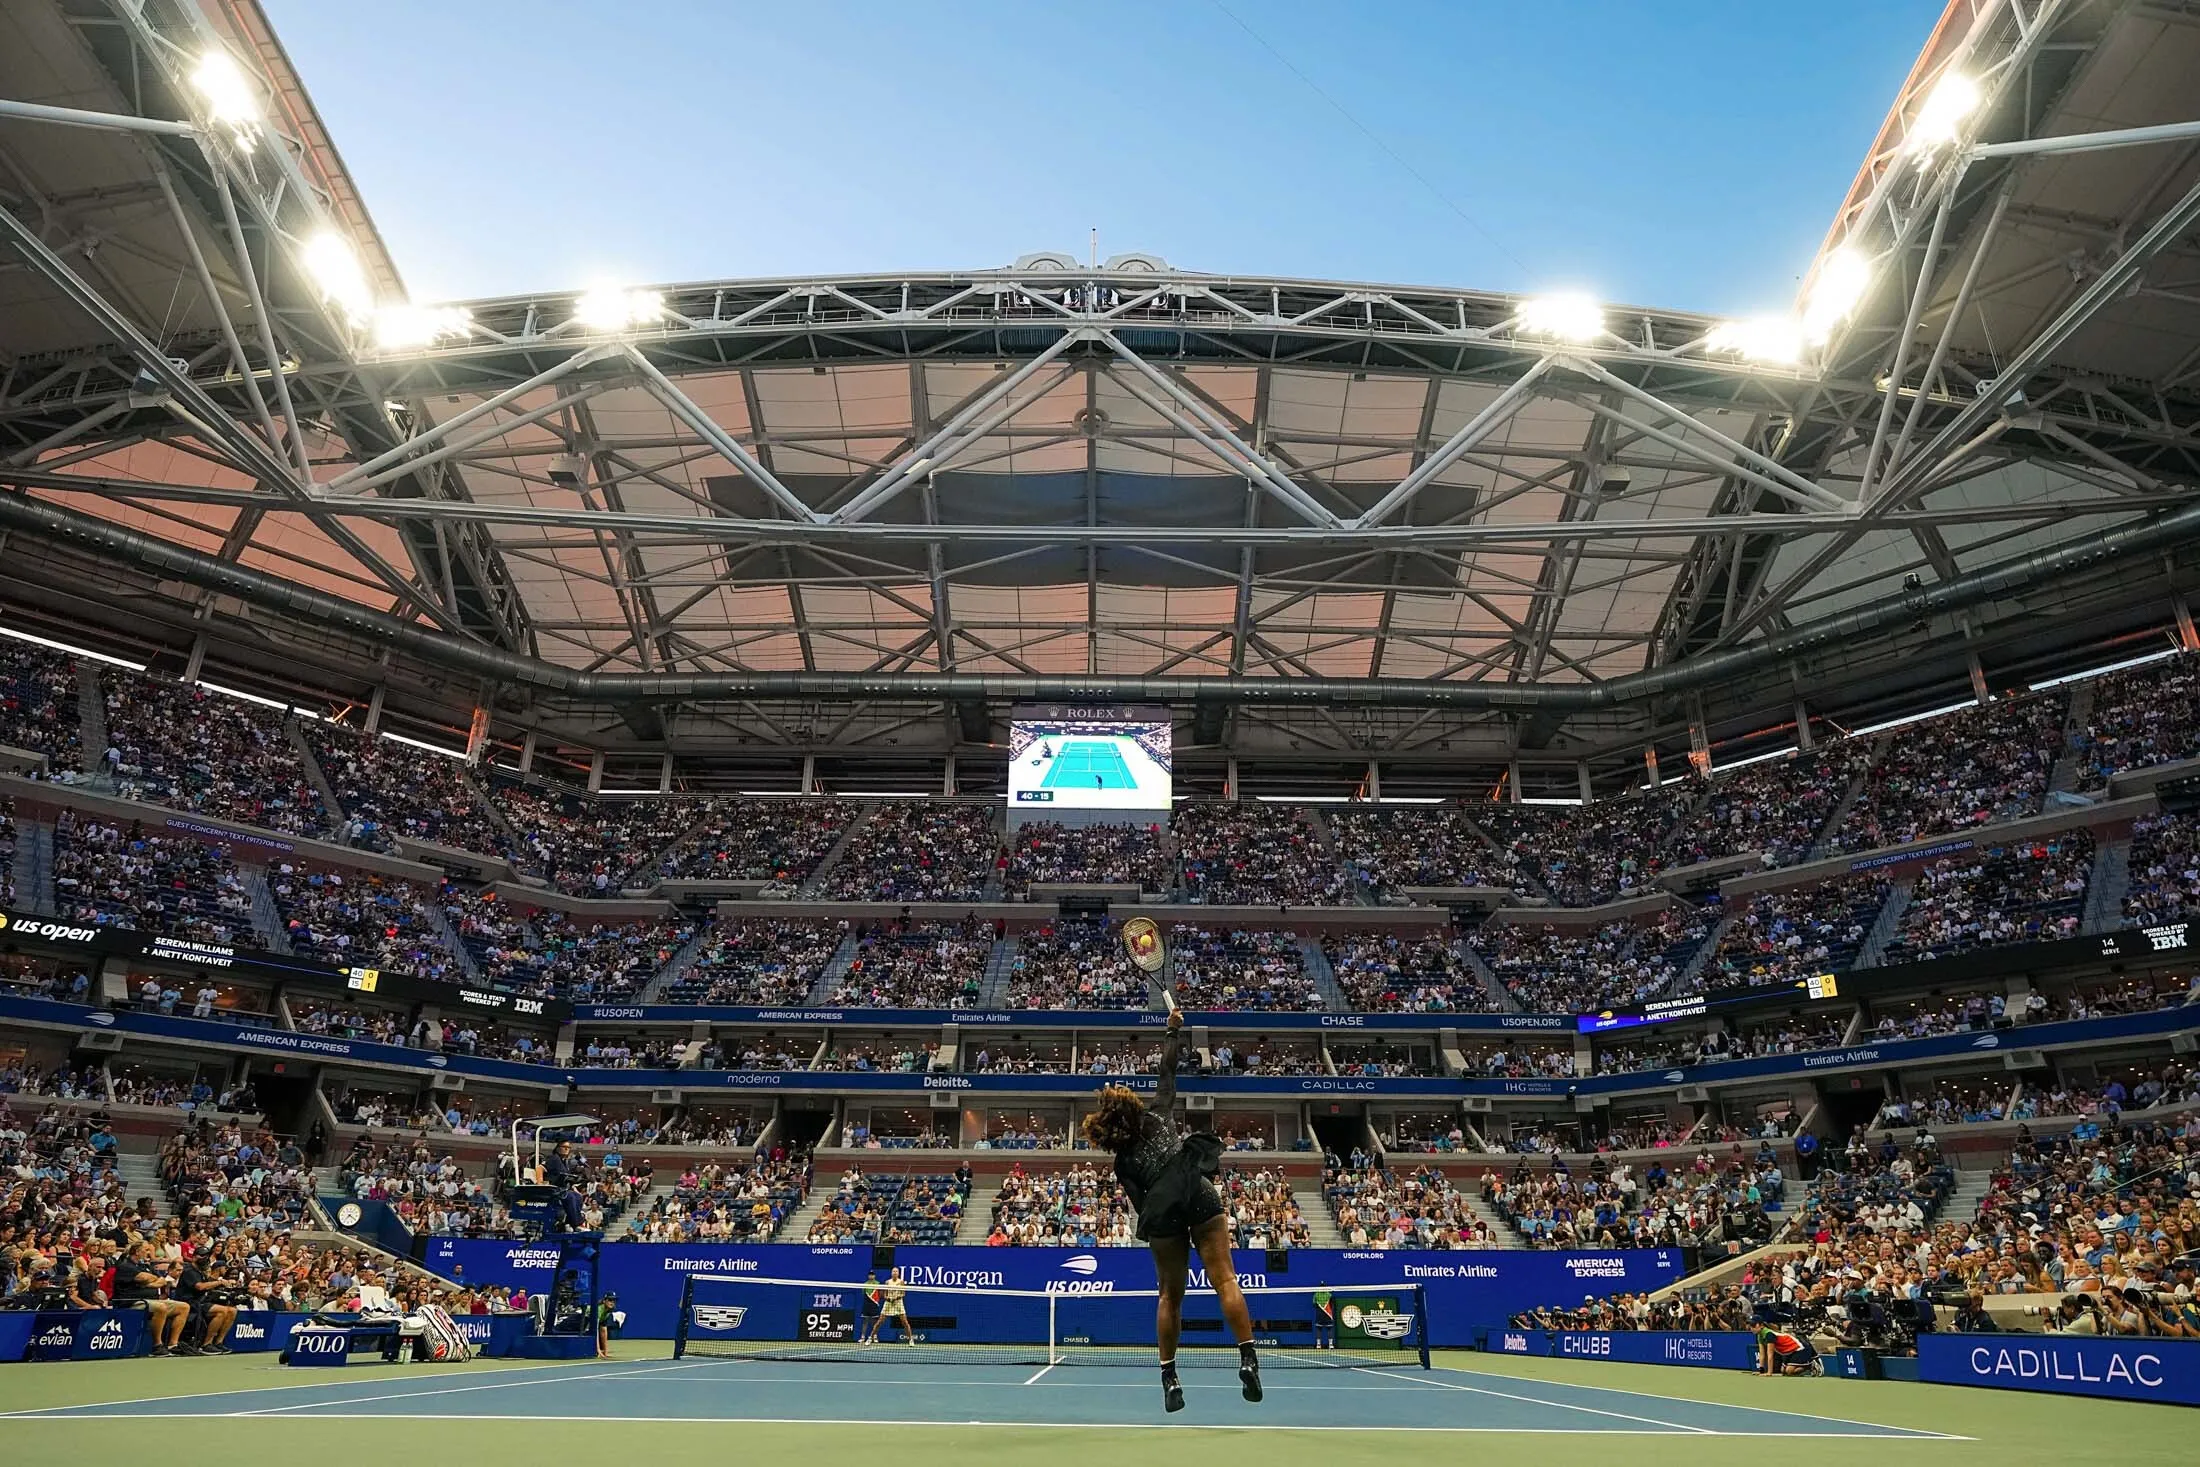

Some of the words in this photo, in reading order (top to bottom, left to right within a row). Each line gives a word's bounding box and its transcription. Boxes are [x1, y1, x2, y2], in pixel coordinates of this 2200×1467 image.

[1067, 708, 1115, 719] ROLEX
[1021, 792, 1033, 800] 40
[166, 819, 190, 829] GUEST
[190, 824, 228, 837] CONCERN?
[229, 832, 246, 841] TEXT
[1851, 861, 1872, 870] GUEST
[1908, 850, 1925, 859] TEXT
[12, 918, 41, 934] us
[40, 923, 96, 942] open
[2142, 926, 2165, 935] SCORES
[2148, 930, 2175, 938] POWERED
[154, 937, 191, 949] SERENA
[192, 943, 234, 956] WILLIAMS
[2102, 938, 2115, 947] 14
[2151, 934, 2187, 950] IBM
[2102, 947, 2120, 955] SERVE
[151, 948, 182, 960] ANETT
[182, 952, 232, 967] KONTAVEIT
[459, 990, 483, 999] SCORES
[488, 994, 506, 1002] STATS
[463, 996, 492, 1006] POWERED
[514, 998, 544, 1015] IBM
[1645, 1001, 1671, 1011] SERENA
[1671, 996, 1705, 1007] WILLIAMS
[593, 1008, 644, 1018] #USOPEN
[757, 1011, 802, 1020] AMERICAN
[803, 1012, 843, 1020] EXPRESS
[952, 1013, 984, 1021] Emirates
[985, 1013, 1011, 1022] Airline
[1646, 1012, 1669, 1021] ANETT
[1669, 1006, 1707, 1017] KONTAVEIT
[1321, 1016, 1364, 1025] CHASE
[1501, 1018, 1562, 1027] USOPEN.ORG
[236, 1032, 298, 1047] AMERICAN
[300, 1040, 351, 1053] EXPRESS
[1803, 1055, 1844, 1066] Emirates
[1846, 1050, 1880, 1061] Airline
[727, 1074, 781, 1084] moderna
[923, 1076, 972, 1088] Deloitte.
[1115, 1080, 1158, 1088] CHUB
[1302, 1081, 1375, 1090] CADILLAC
[1505, 1082, 1526, 1092] IHG
[443, 1241, 453, 1249] 14
[811, 1247, 854, 1255] USOPEN.ORG
[1657, 1251, 1668, 1259] 14
[512, 1260, 560, 1269] EXPRES
[664, 1258, 715, 1271] Emirates
[717, 1258, 758, 1271] Airline
[1565, 1258, 1624, 1268] AMERICAN
[1404, 1264, 1455, 1277] Emirates
[1457, 1265, 1498, 1278] Airline
[1574, 1268, 1626, 1277] EXPRESS
[899, 1265, 1004, 1290] J.P.Morgan
[1045, 1280, 1067, 1293] us
[1067, 1280, 1114, 1294] open
[813, 1294, 842, 1308] IBM
[806, 1313, 831, 1331] 95
[837, 1323, 853, 1331] MPH
[235, 1323, 265, 1339] Wilson
[39, 1333, 73, 1346] evian
[90, 1332, 123, 1350] evian
[295, 1335, 345, 1353] POLO
[1564, 1336, 1610, 1355] CHUBB
[1687, 1339, 1707, 1348] HOTELS
[1708, 1340, 1713, 1348] &
[1665, 1338, 1686, 1360] IHG
[1687, 1351, 1713, 1361] RESORTS
[1846, 1354, 1855, 1366] 14
[1971, 1346, 2164, 1387] CADILLAC
